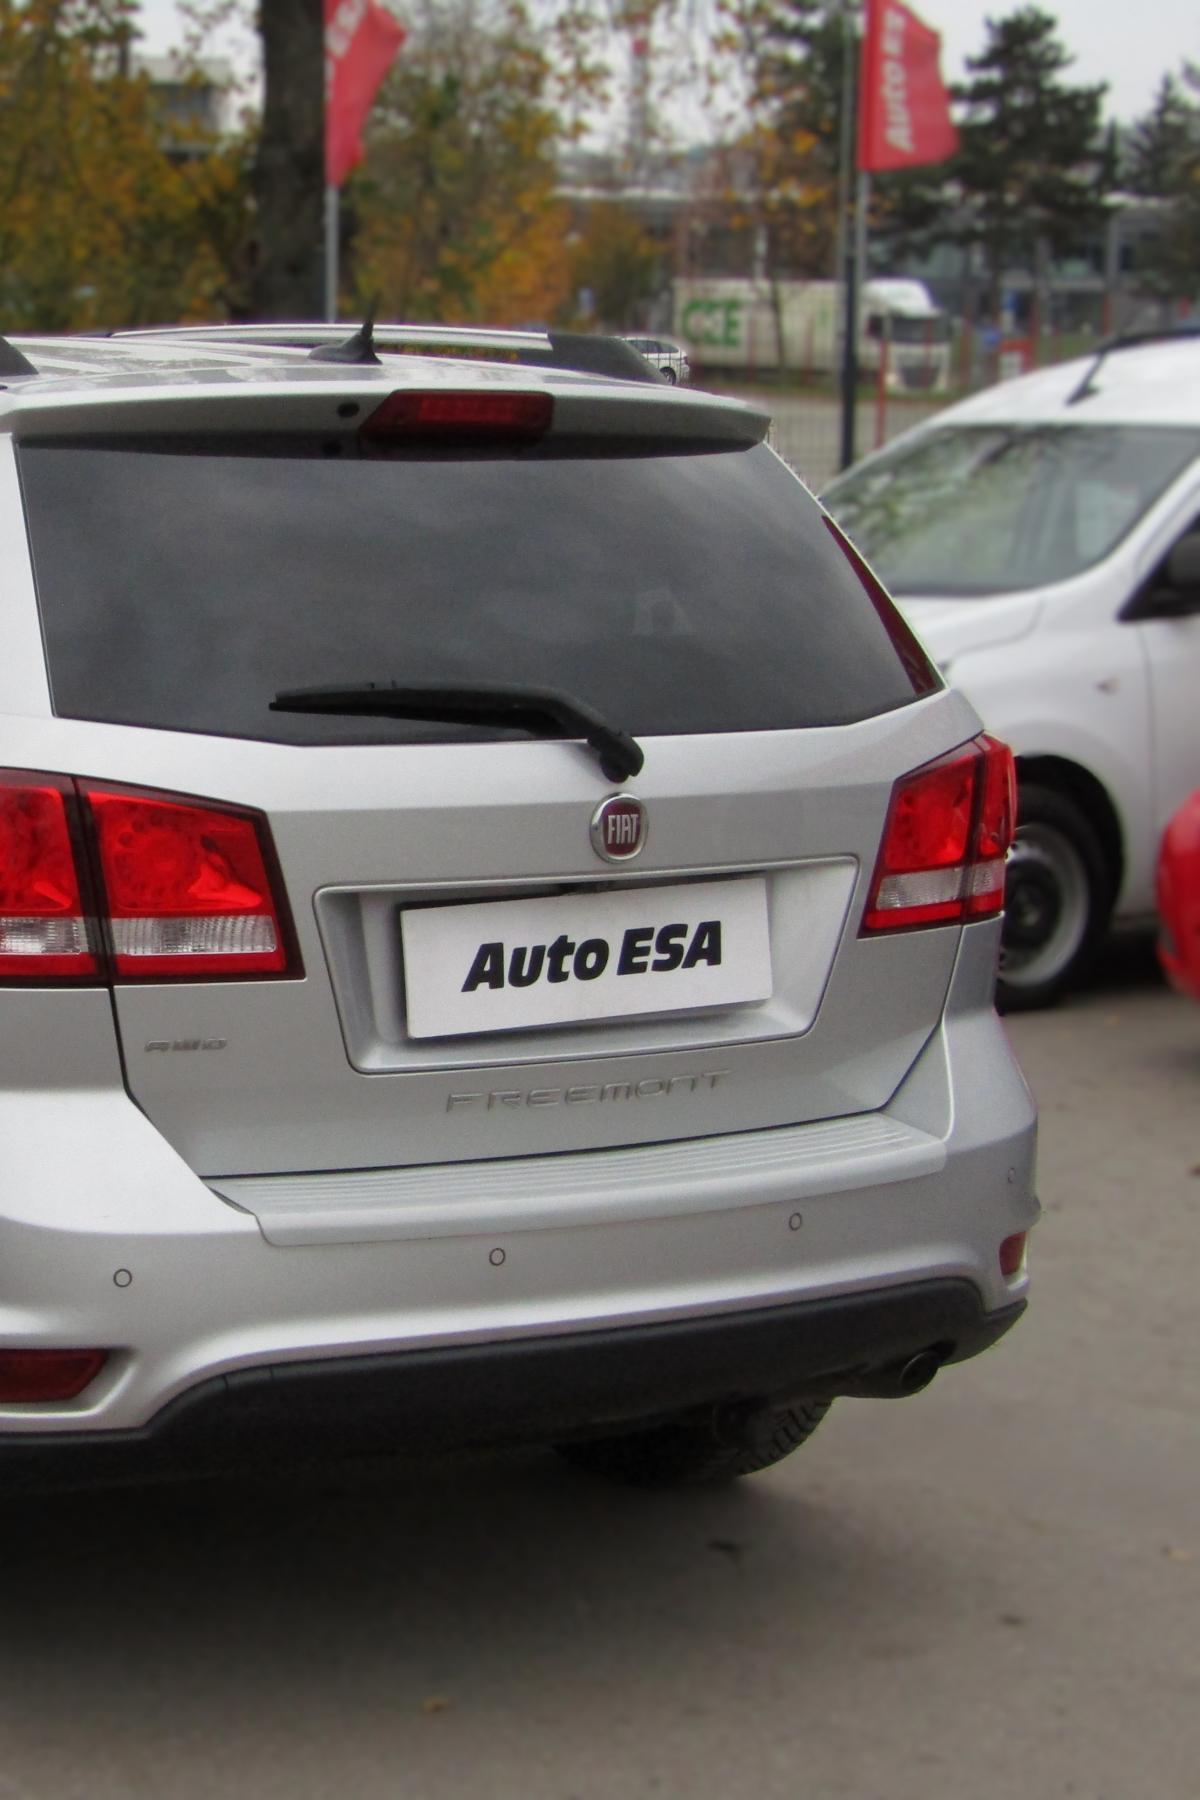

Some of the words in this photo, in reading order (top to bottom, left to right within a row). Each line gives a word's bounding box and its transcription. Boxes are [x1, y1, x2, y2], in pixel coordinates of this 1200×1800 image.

[607, 813, 639, 845] FIAT
[461, 934, 610, 993] Auto
[616, 920, 722, 976] ESA
[446, 1069, 733, 1113] FREEMONT
